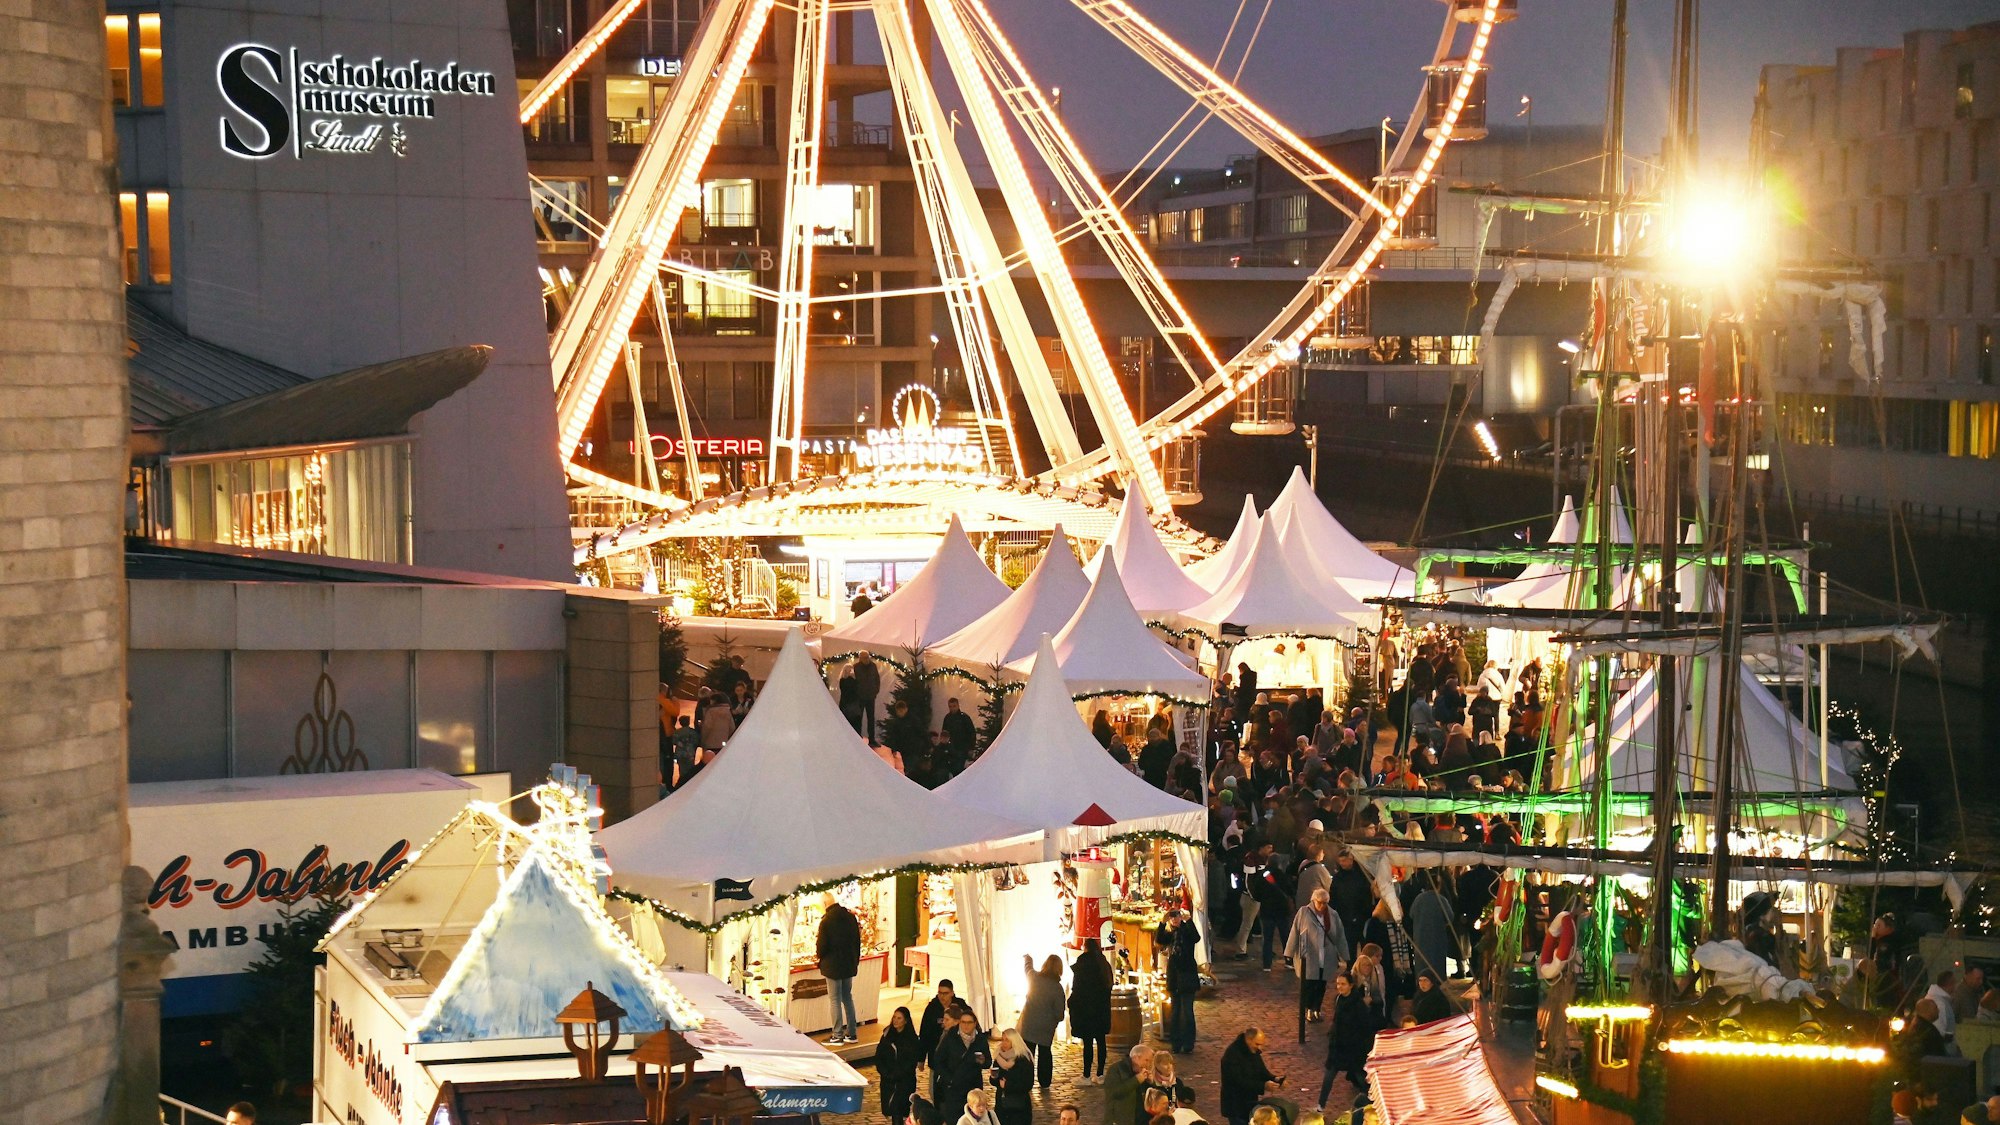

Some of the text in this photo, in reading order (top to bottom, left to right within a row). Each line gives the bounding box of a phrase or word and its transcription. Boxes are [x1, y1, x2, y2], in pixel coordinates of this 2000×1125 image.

[301, 54, 496, 95] schokoladen
[302, 89, 435, 118] museum
[304, 119, 383, 153] Lindt
[801, 439, 857, 454] PASTA
[866, 428, 901, 445] DAS
[856, 444, 983, 467] RIESENRAD
